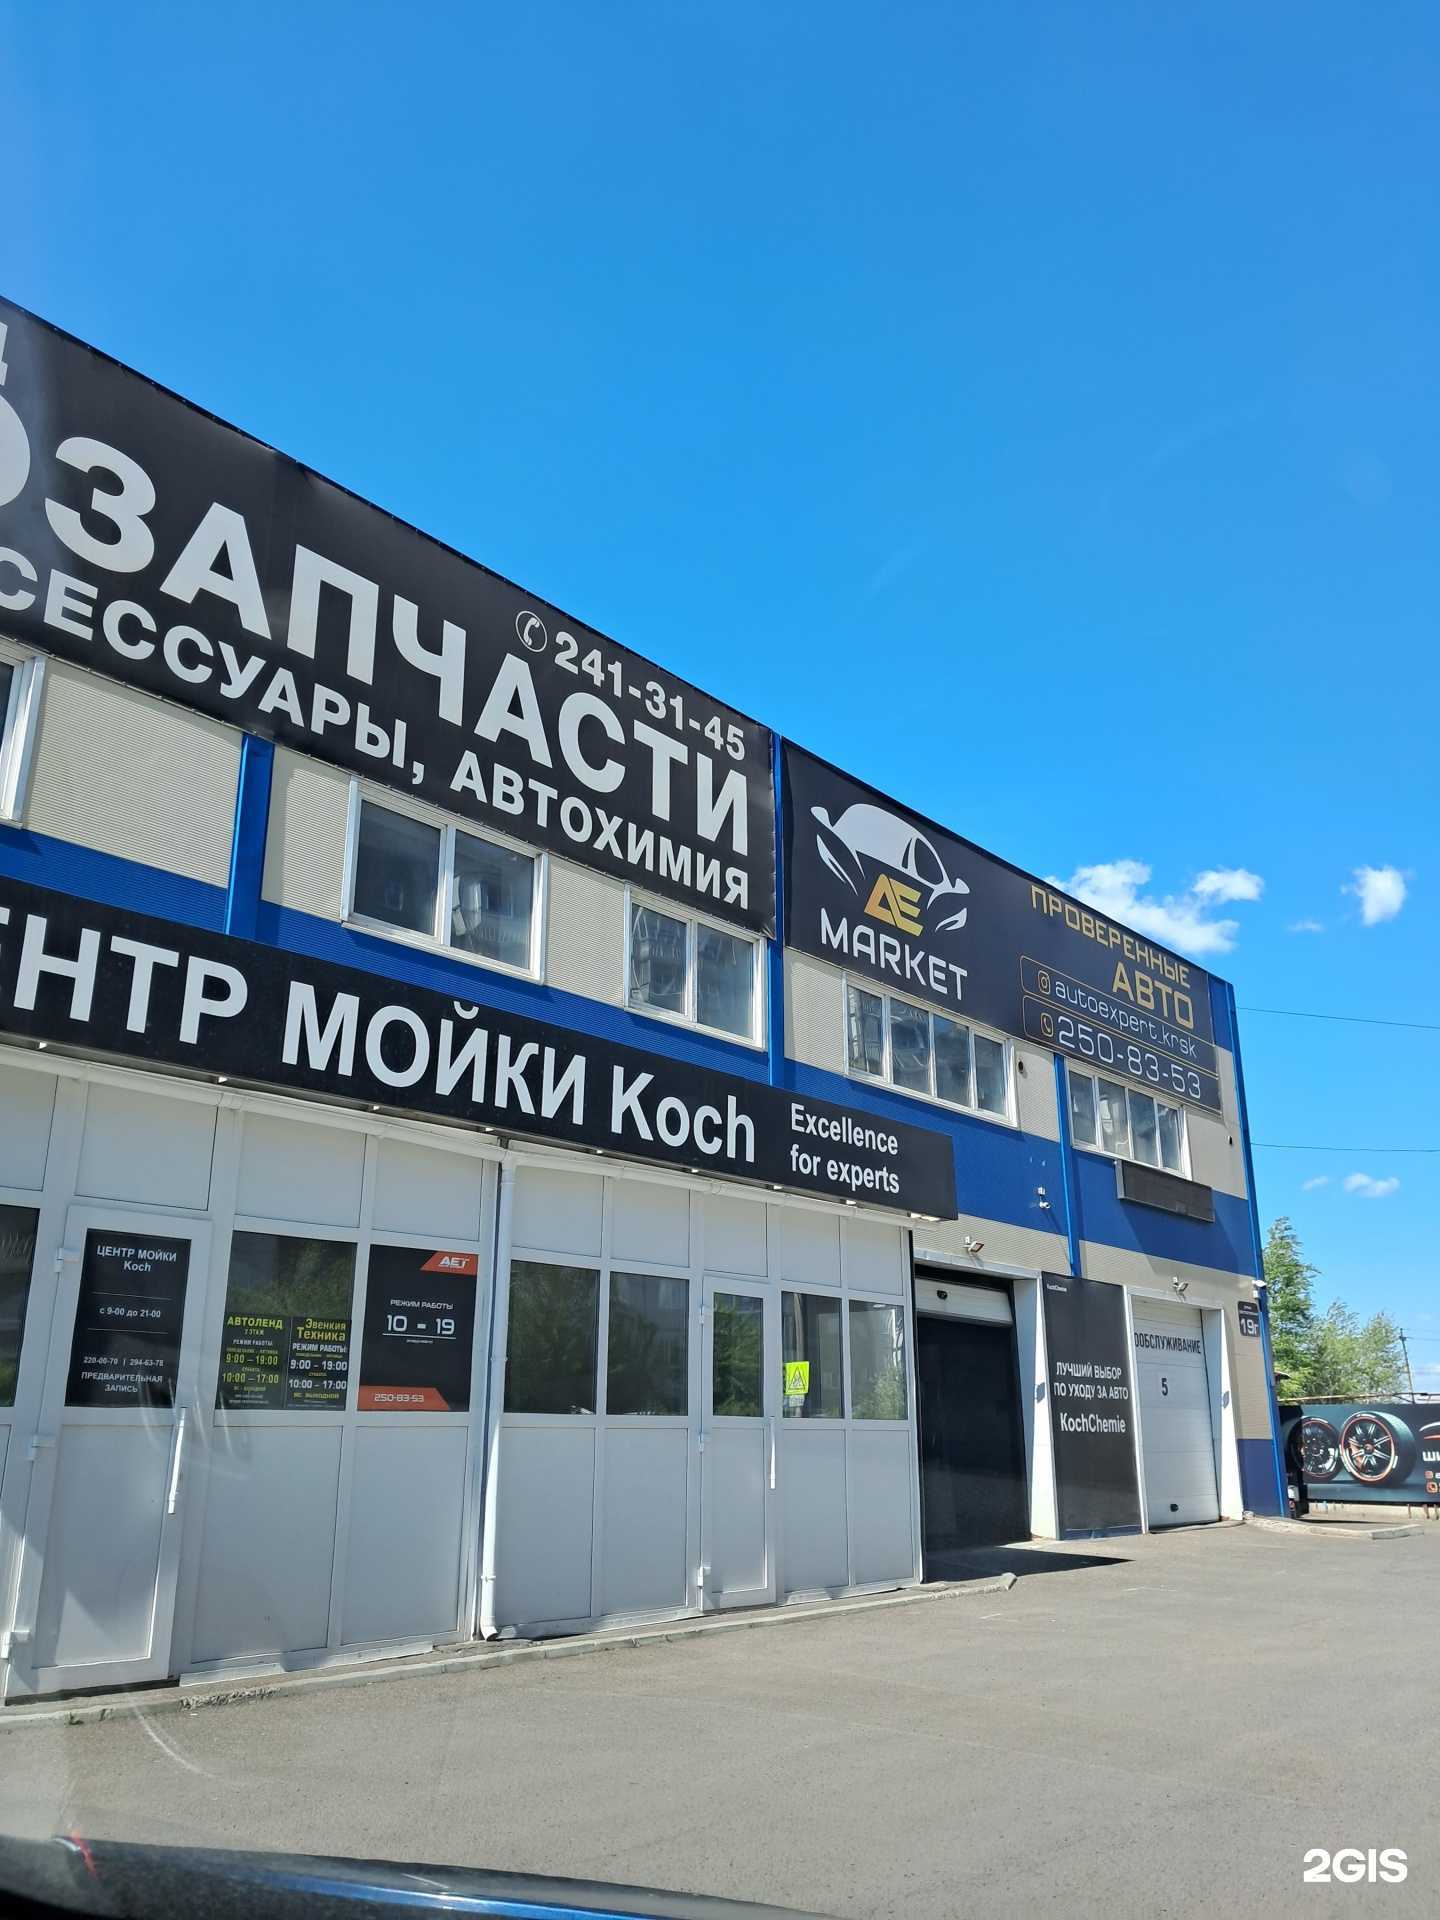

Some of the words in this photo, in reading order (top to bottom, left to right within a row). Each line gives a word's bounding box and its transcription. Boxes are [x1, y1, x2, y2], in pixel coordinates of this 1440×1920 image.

[554, 631, 746, 761] 241-31-45
[450, 750, 749, 911] АВТОХИМИЯ
[1031, 885, 1192, 988] ПРОВЕРЕННЫЕ
[820, 907, 968, 1001] MARKET
[1112, 962, 1194, 1030] АВТО
[0, 907, 249, 1045] НТР
[282, 981, 586, 1126] МОЙКИ
[611, 1065, 755, 1163] Koch
[1057, 1016, 1201, 1099] 250-83-53
[790, 1102, 899, 1156] Excellence
[790, 1145, 820, 1177] for
[827, 1157, 900, 1194] experts
[97, 1245, 135, 1257] ЦЕНТР
[138, 1248, 177, 1262] МОЙКИ
[124, 1261, 151, 1272] Koch
[390, 1299, 420, 1308] РЕЖИМ
[421, 1301, 454, 1310] РАБОТЫ
[126, 1310, 138, 1318] до
[227, 1316, 284, 1330] АВТОЛЕНД
[387, 1314, 408, 1332] 10
[435, 1318, 455, 1335] 19
[296, 1326, 346, 1342] Техника
[292, 1342, 319, 1351] РЕЖИМ
[320, 1344, 347, 1353] РАБОТЫ
[226, 1353, 245, 1364] 9:00
[255, 1354, 279, 1366] 19:00
[291, 1359, 311, 1370] 9:00
[321, 1360, 348, 1371] 19:00
[81, 1371, 163, 1383] ПРЕДВАРИТЕЛЬНАЯ
[222, 1372, 246, 1383] 10:00
[256, 1374, 279, 1384] 17:00
[1056, 1361, 1093, 1378] ЛУЧШИЙ
[1094, 1364, 1122, 1380] ВЫБОР
[105, 1384, 138, 1393] ЗАПИСЬ
[289, 1379, 313, 1389] 10:00
[322, 1380, 347, 1390] 17:00
[1054, 1382, 1067, 1396] ПО
[1068, 1383, 1095, 1400] УХОДУ
[1097, 1385, 1108, 1399] ЗА
[1109, 1386, 1129, 1400] АВТО
[1161, 1377, 1169, 1396] 5
[1060, 1412, 1126, 1433] KochChemie
